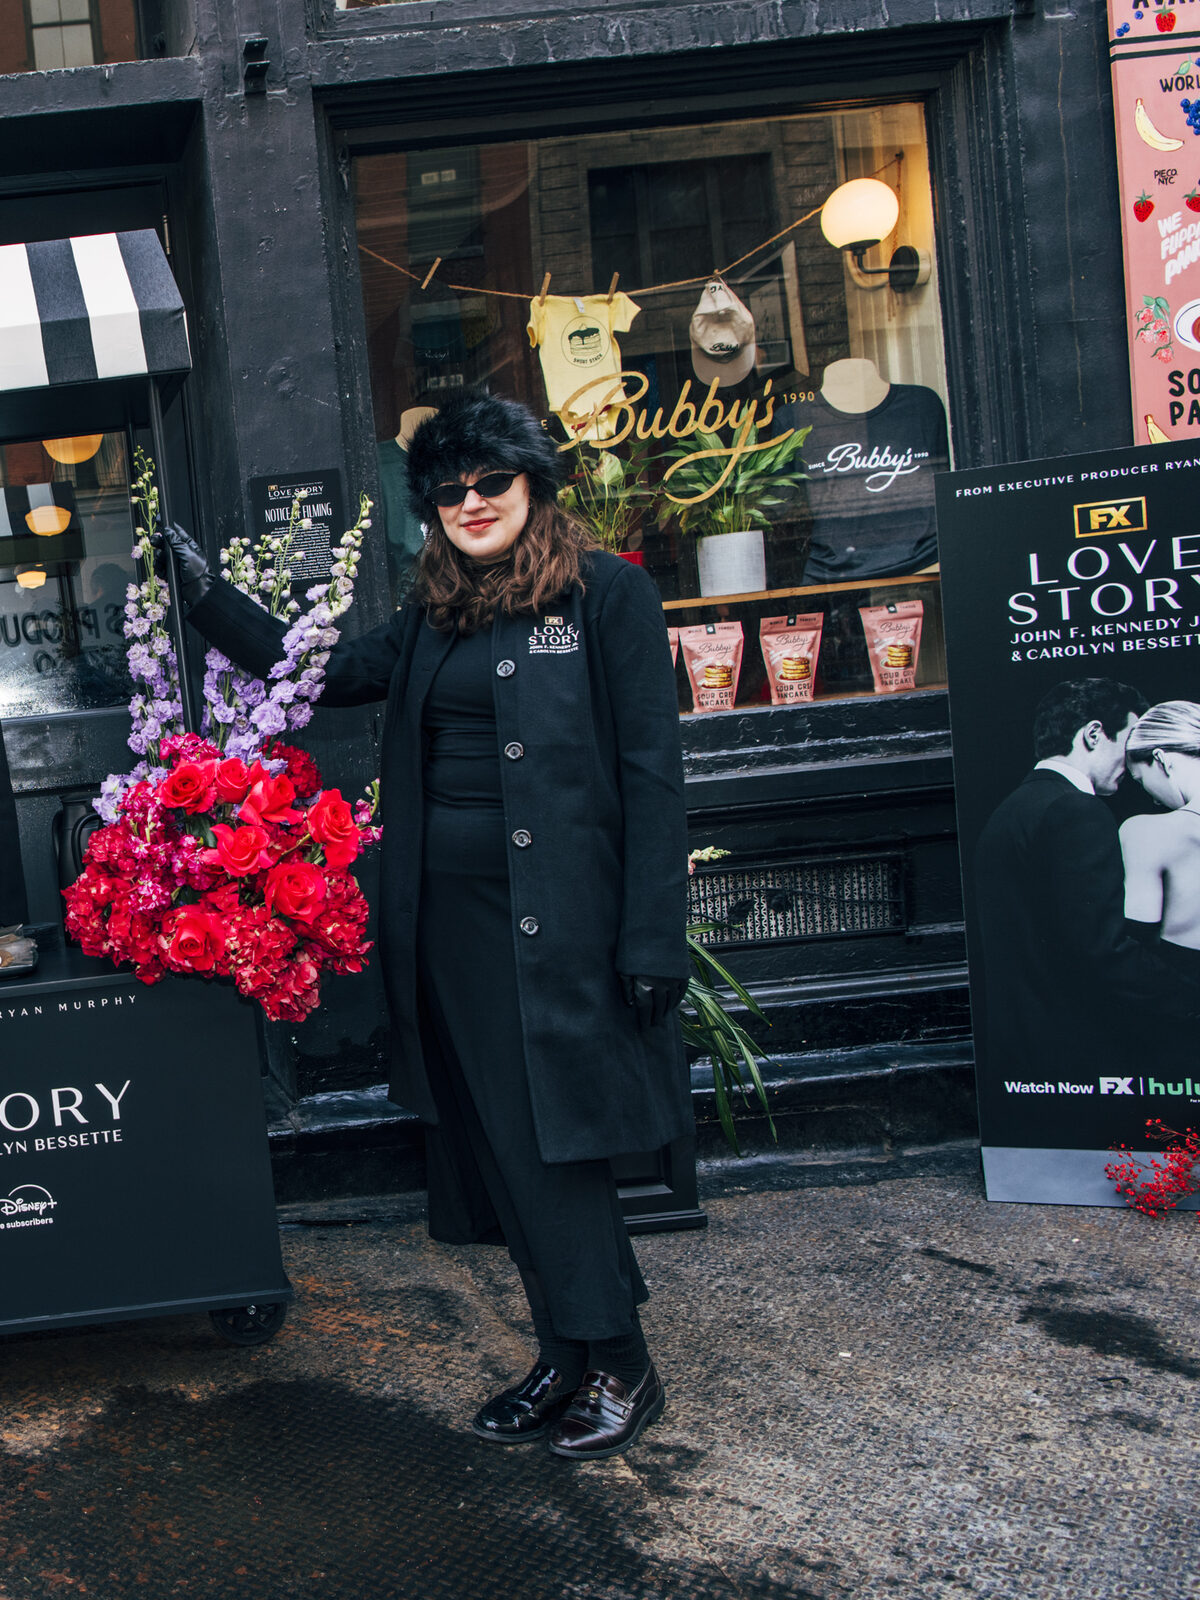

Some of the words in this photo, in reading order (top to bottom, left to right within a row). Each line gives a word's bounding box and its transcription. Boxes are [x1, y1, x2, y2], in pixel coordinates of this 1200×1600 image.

[1158, 176, 1176, 186] NYC
[1157, 211, 1184, 238] WE
[783, 391, 815, 404] 1990
[556, 370, 796, 504] Bubby's
[808, 461, 826, 470] SINCE
[823, 442, 921, 493] Bubby's
[955, 485, 993, 498] FROM
[998, 474, 1075, 493] EXECUTIVE
[1080, 463, 1159, 482] PRODUCER
[1165, 458, 1200, 471] RYAN
[268, 488, 292, 498] LOVE
[264, 507, 290, 523] NOTICE
[302, 502, 333, 519] FILMING
[1089, 504, 1132, 530] FX
[1028, 534, 1200, 586] LOVE
[528, 630, 580, 645] STORY
[533, 622, 575, 636] LOVE
[1010, 629, 1061, 645] JOHN
[1070, 627, 1086, 639] F.
[1091, 617, 1182, 637] KENNEDY
[1011, 650, 1023, 662] &
[1026, 642, 1115, 661] CAROLYN
[58, 994, 138, 1011] MURPHY
[1004, 1081, 1056, 1095] Watch
[1058, 1081, 1095, 1095] Now
[1099, 1076, 1135, 1095] FX
[35, 1129, 124, 1152] BESSETTE
[6, 1216, 54, 1230] subscribers
